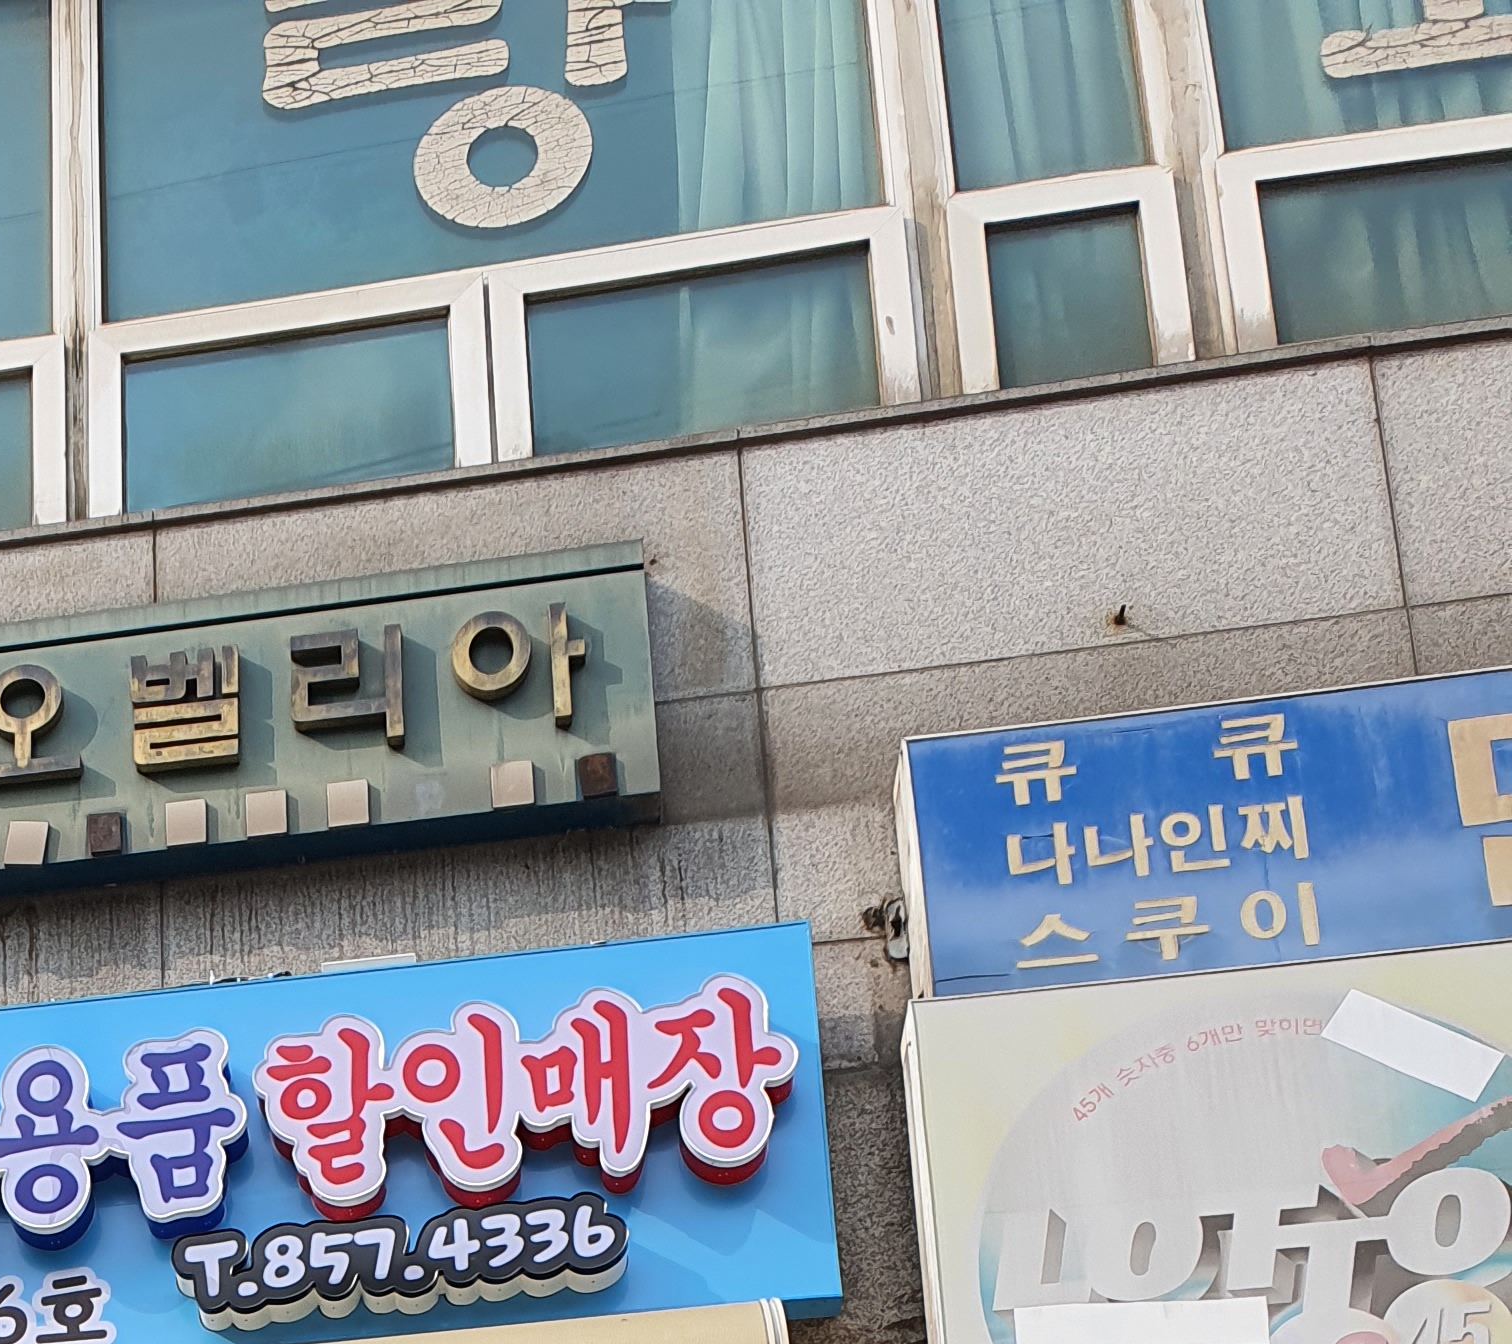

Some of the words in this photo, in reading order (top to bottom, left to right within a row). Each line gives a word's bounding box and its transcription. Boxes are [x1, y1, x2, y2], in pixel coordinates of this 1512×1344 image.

[1006, 796, 1309, 886] 나나인찌
[1017, 881, 1320, 969] 스쿠이
[259, 980, 790, 1196] 할인매장
[1072, 1082, 1115, 1122] 45개
[1186, 1023, 1243, 1052] 6개만
[183, 1204, 619, 1300] T.857.4336
[993, 1167, 1510, 1314] LOTTO
